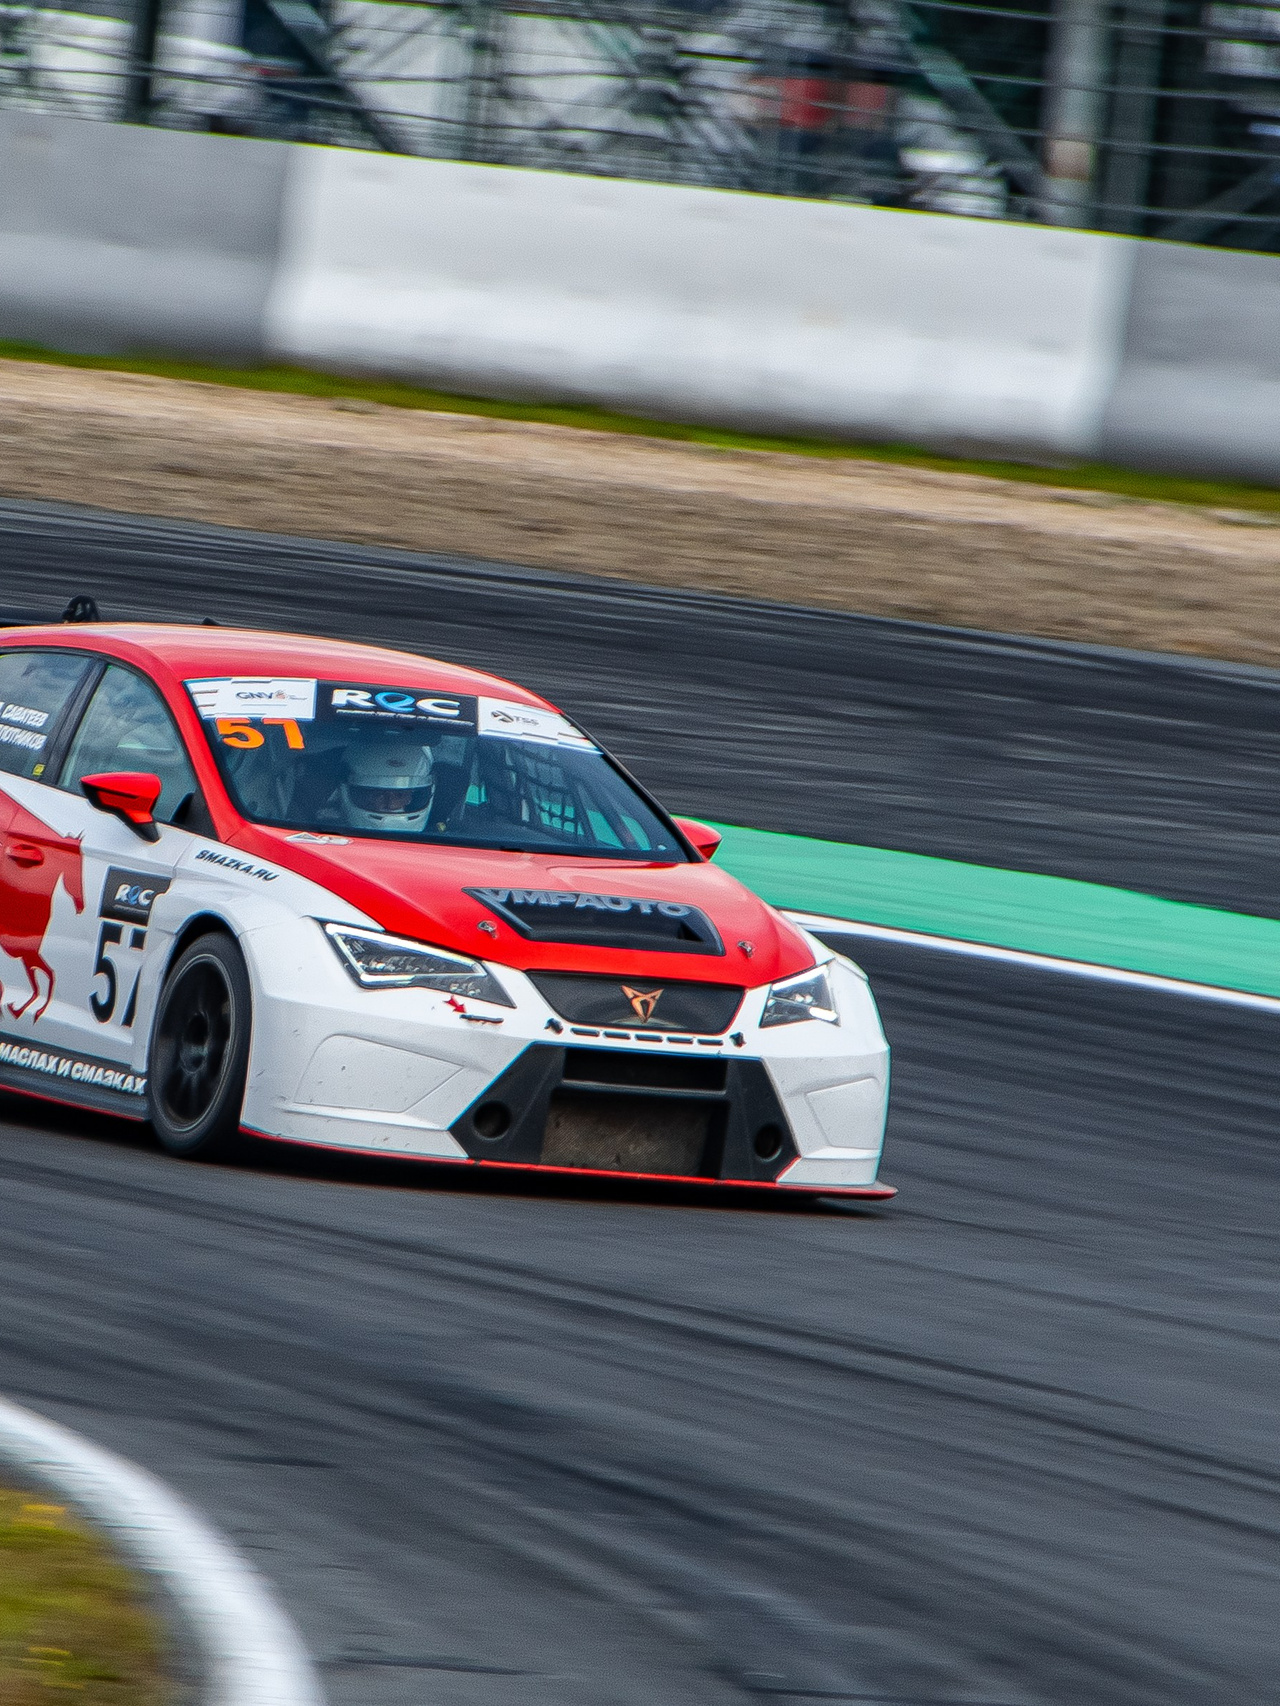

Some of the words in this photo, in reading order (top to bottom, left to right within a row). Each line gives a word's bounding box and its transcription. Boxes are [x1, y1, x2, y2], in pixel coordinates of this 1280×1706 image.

[216, 718, 304, 749] 57
[195, 849, 280, 881] SMAZKA.RU
[478, 889, 691, 917] VMPAUTO
[89, 921, 148, 1028] 57
[56, 1058, 73, 1078] И
[70, 1061, 148, 1096] СМАЗКАХ
